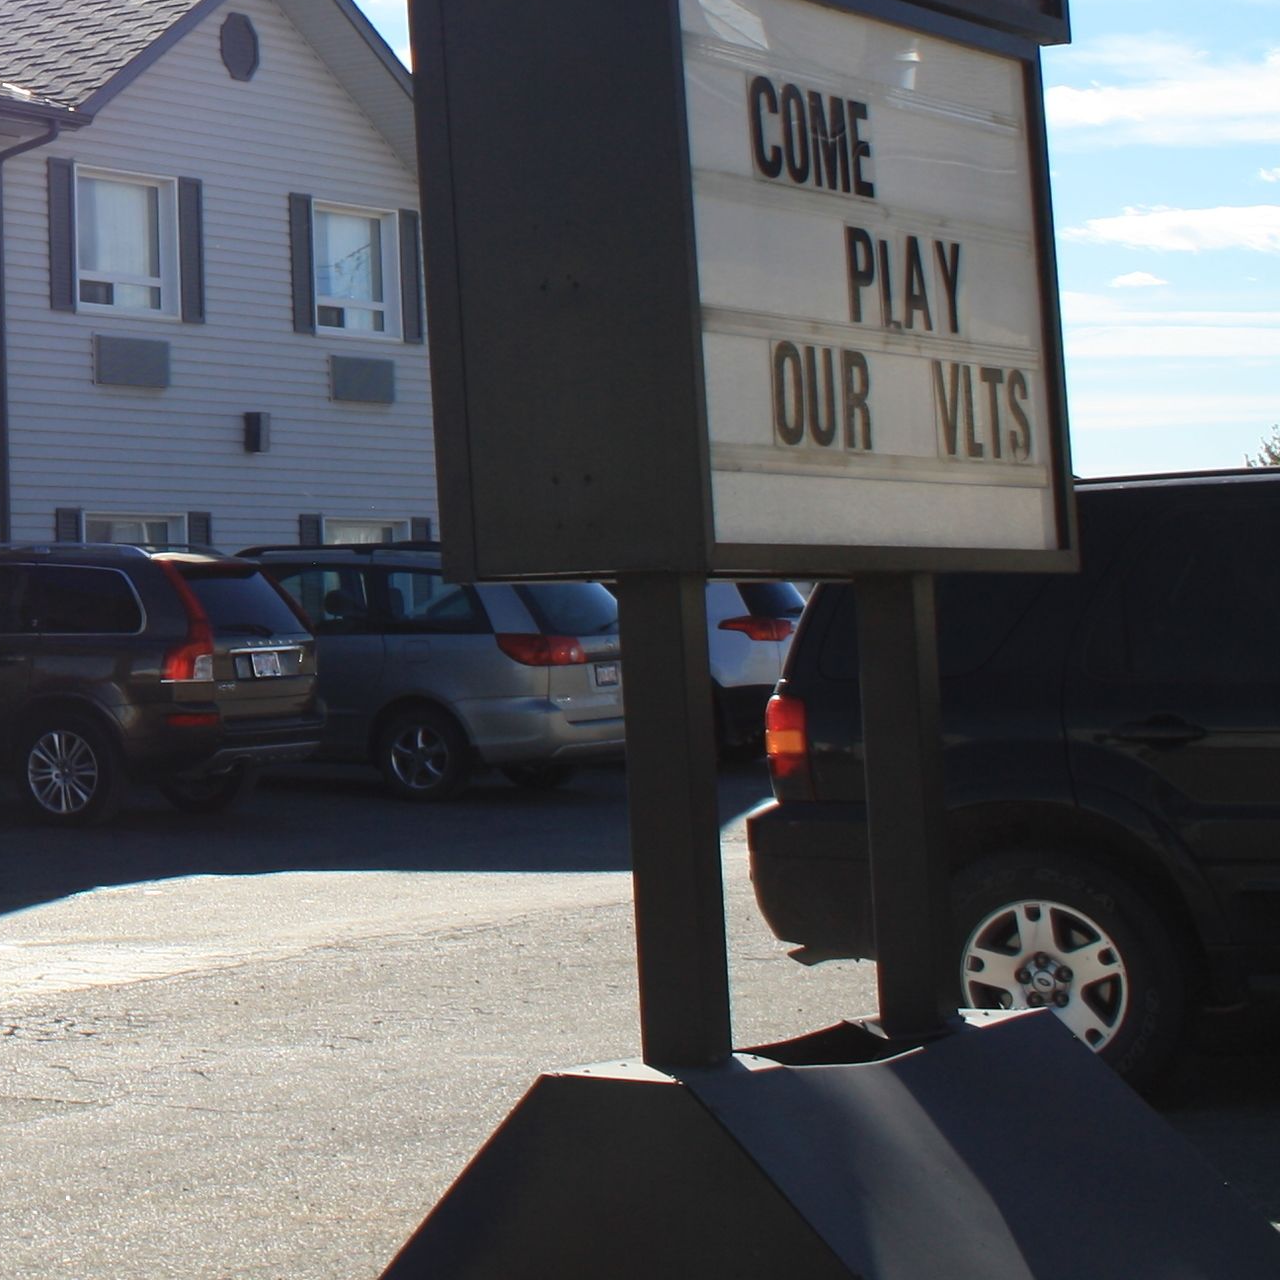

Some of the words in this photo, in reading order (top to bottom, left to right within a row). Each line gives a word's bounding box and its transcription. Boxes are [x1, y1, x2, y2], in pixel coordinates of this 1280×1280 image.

[748, 75, 875, 199] COME
[845, 226, 961, 335] PLAY
[773, 340, 872, 452] OUR
[934, 360, 1031, 462] VLTS
